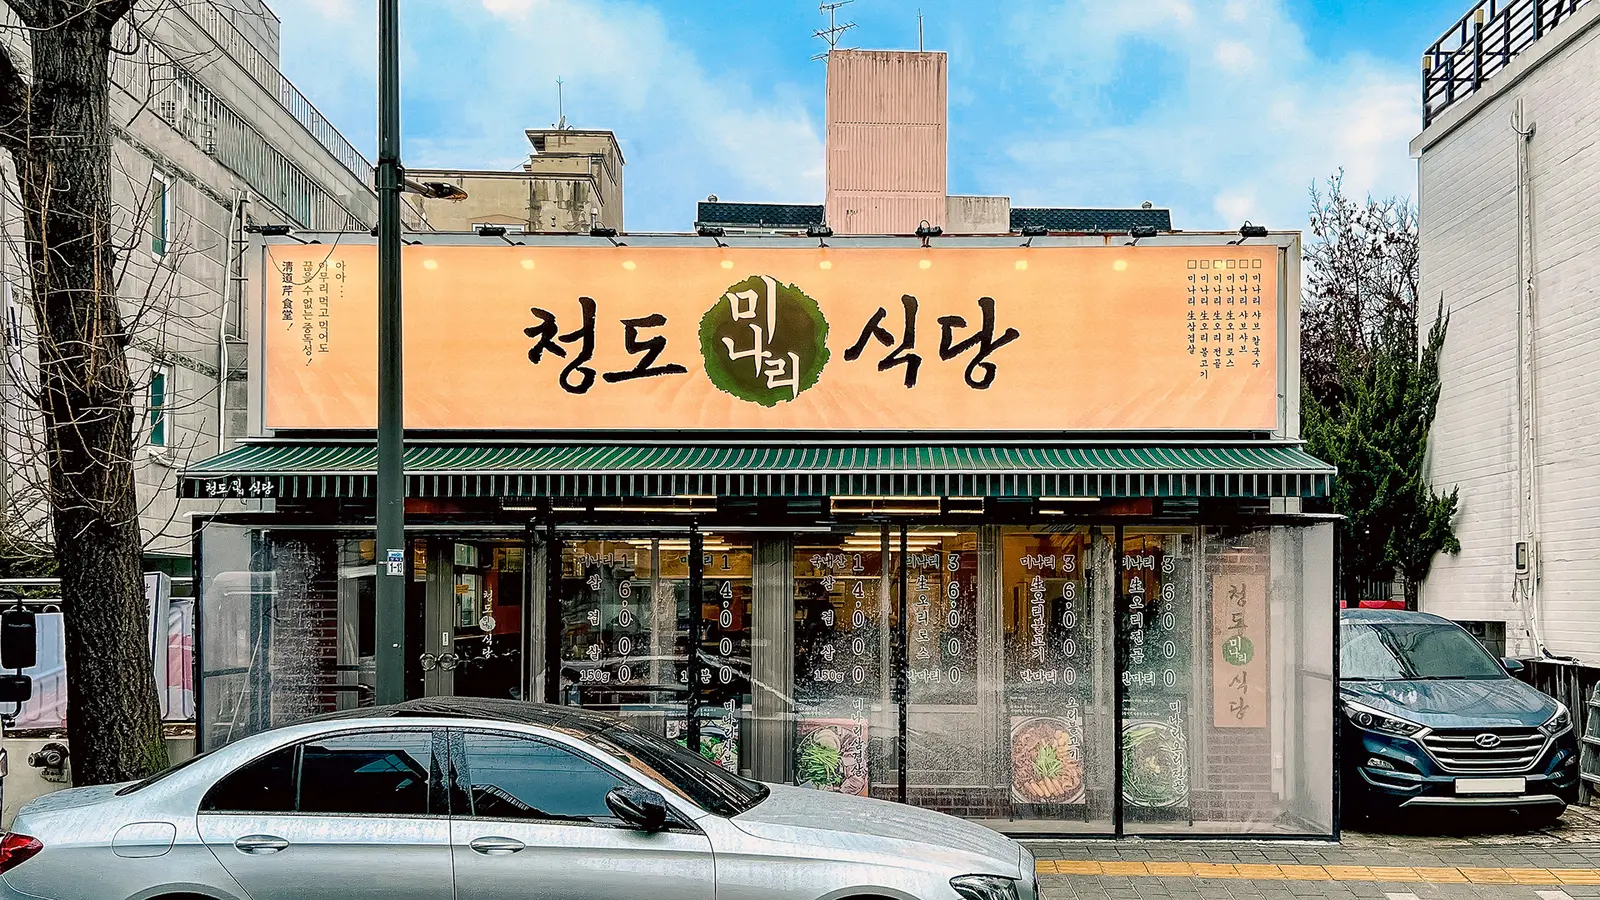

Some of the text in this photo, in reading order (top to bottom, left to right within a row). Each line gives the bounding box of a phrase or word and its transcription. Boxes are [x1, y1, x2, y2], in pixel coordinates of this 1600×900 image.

[1187, 273, 1196, 306] 미나리
[1200, 273, 1209, 306] 미나리
[1213, 273, 1222, 306] 미나리
[1226, 273, 1236, 306] 미나리
[302, 260, 313, 367] 끊을 수 없는 중독성!
[318, 260, 329, 353] 아무리 먹고 먹어도
[1239, 273, 1248, 353] 미나리 샤브샤브
[1252, 273, 1261, 368] 미나리 샤브 칼국수
[522, 274, 1020, 399] 청도 미나리 식당
[1200, 347, 1209, 379] 불고기
[1213, 348, 1222, 368] 전골
[1226, 348, 1236, 367] 로스
[205, 481, 229, 496] 청도
[249, 481, 274, 495] 식당
[579, 552, 615, 568] 미나리
[809, 553, 847, 569] 국내산
[1019, 554, 1056, 570] 미나리
[482, 590, 493, 614] 청도
[482, 633, 493, 660] 식당
[1228, 583, 1250, 720] 청도 미나리 식당
[579, 669, 610, 683] 150g
[813, 669, 844, 683] 150g
[1019, 669, 1057, 685] 반마리
